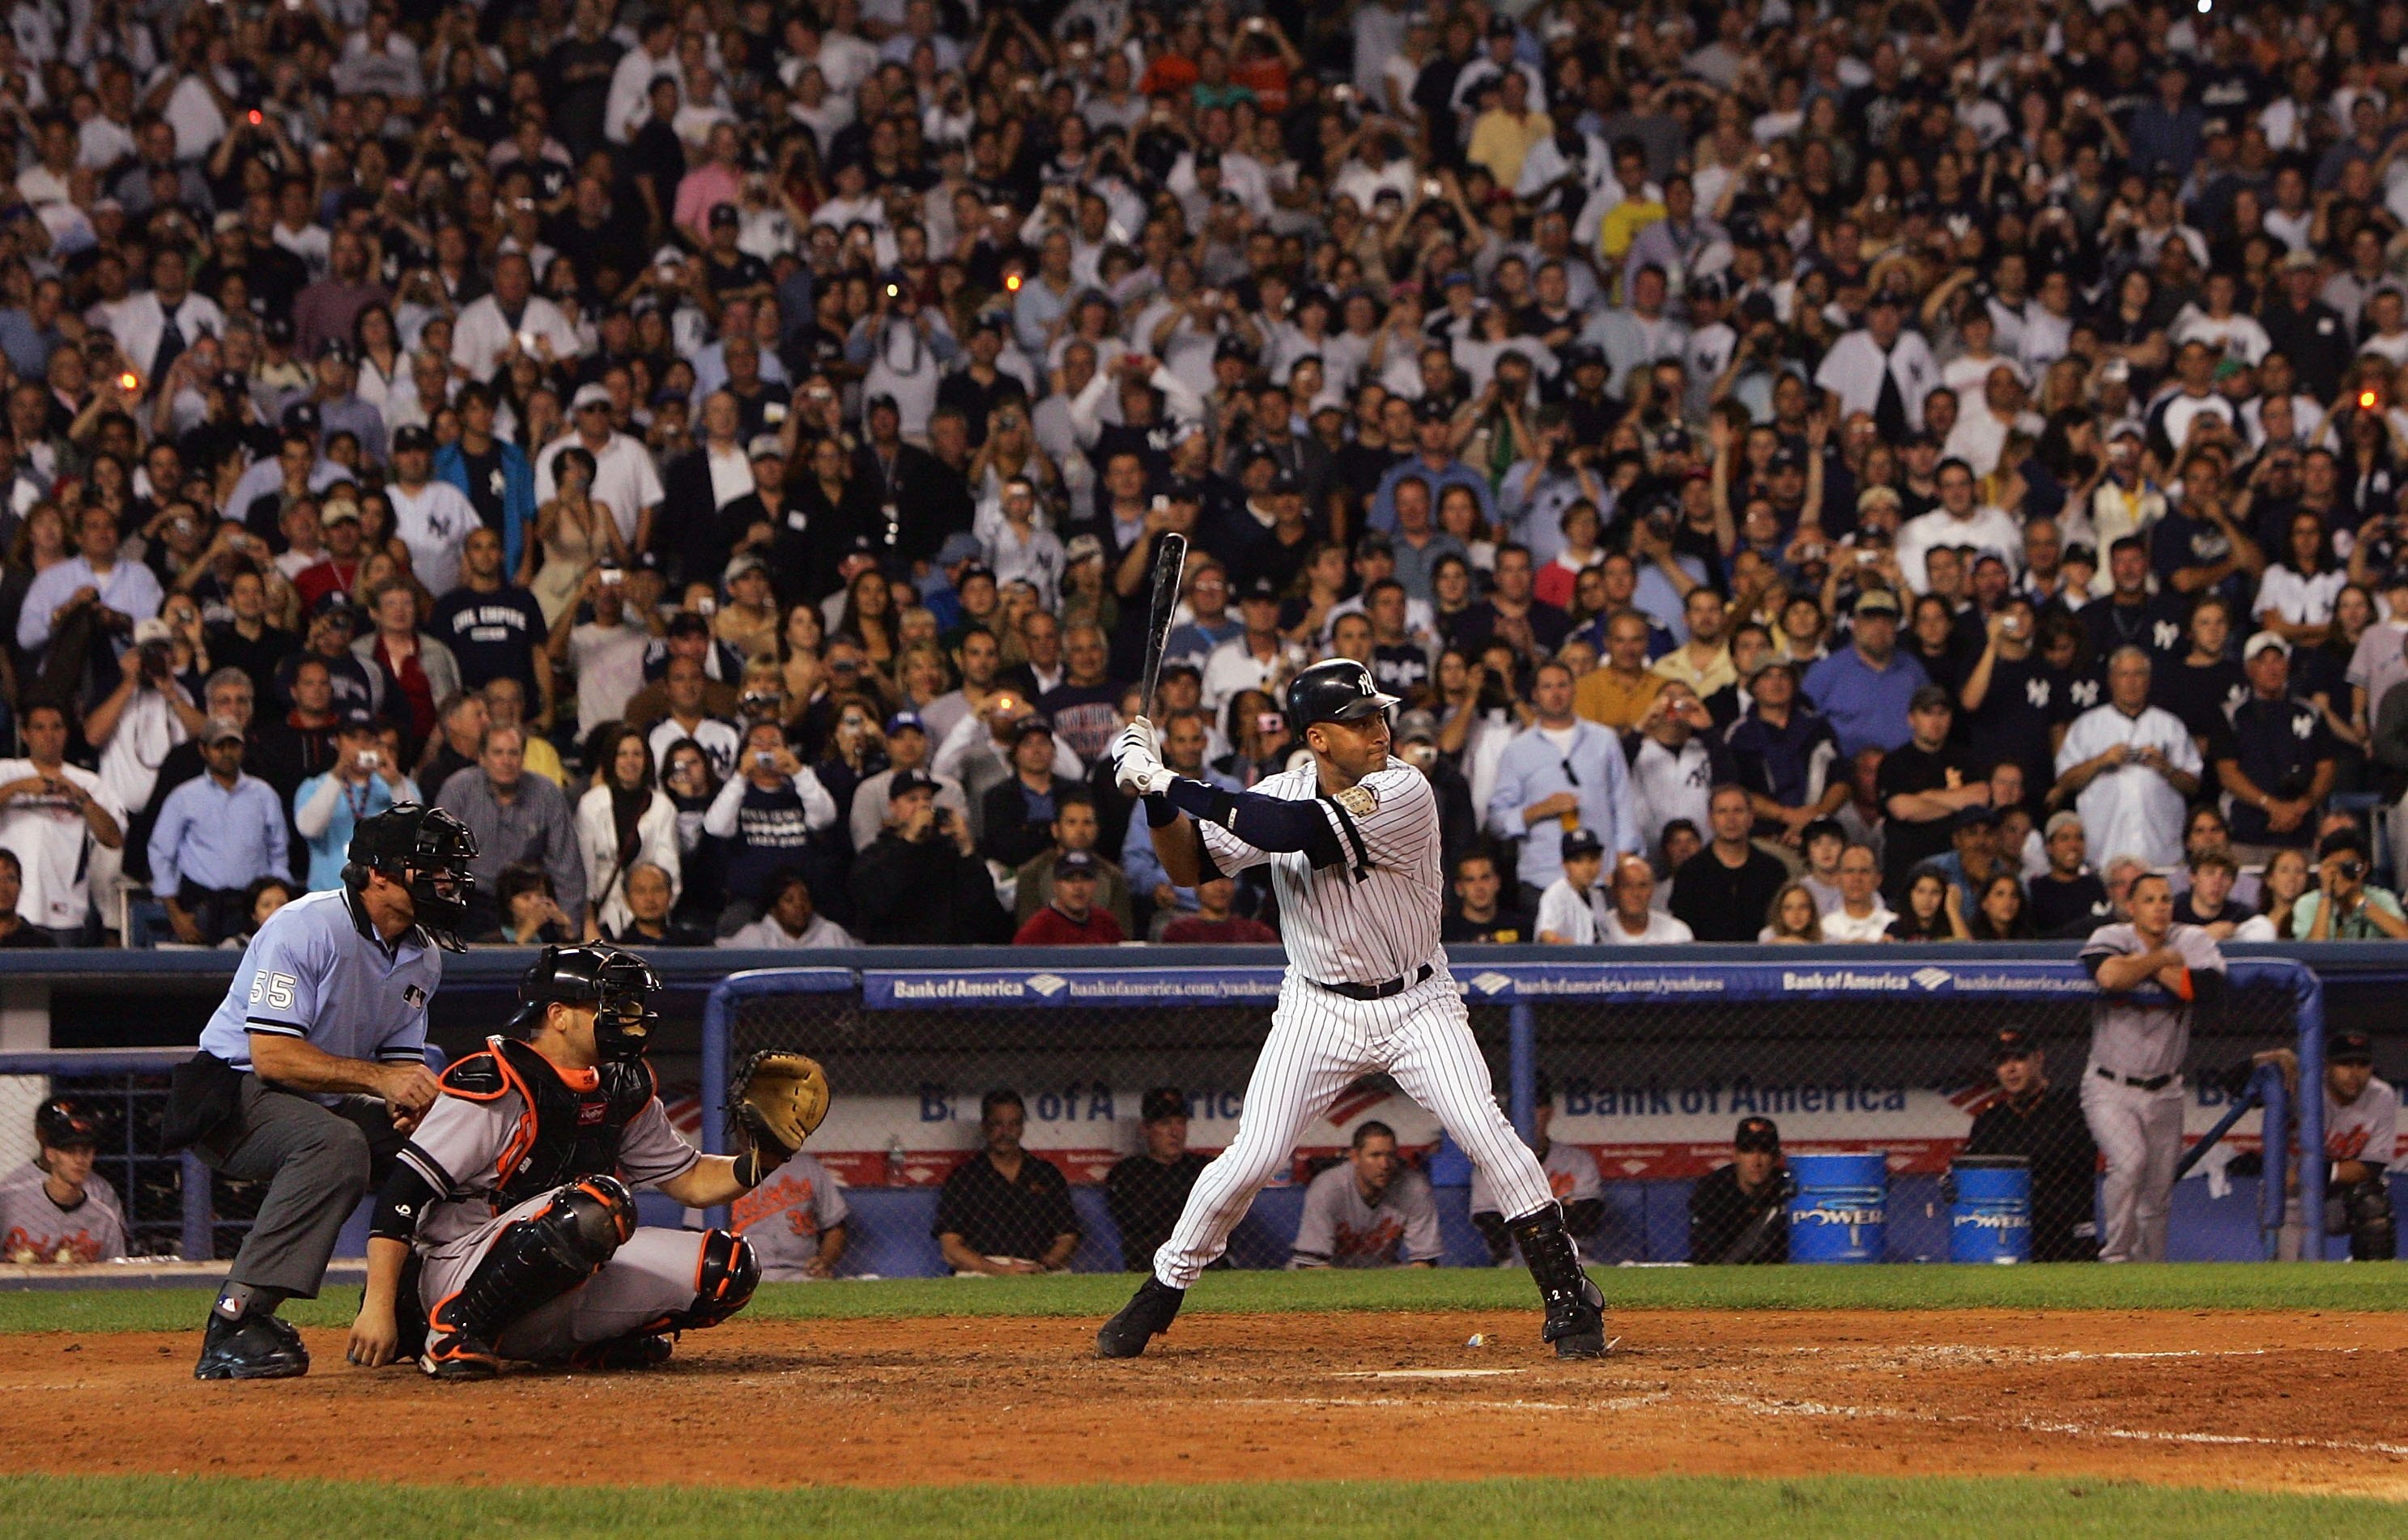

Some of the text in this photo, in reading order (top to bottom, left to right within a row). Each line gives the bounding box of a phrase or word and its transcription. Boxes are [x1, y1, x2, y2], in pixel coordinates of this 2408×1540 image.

[250, 970, 296, 1010] 55
[894, 979, 1024, 998] Bank of America
[1783, 972, 1909, 990] Bank of America
[1564, 1075, 1906, 1116] Bank of America
